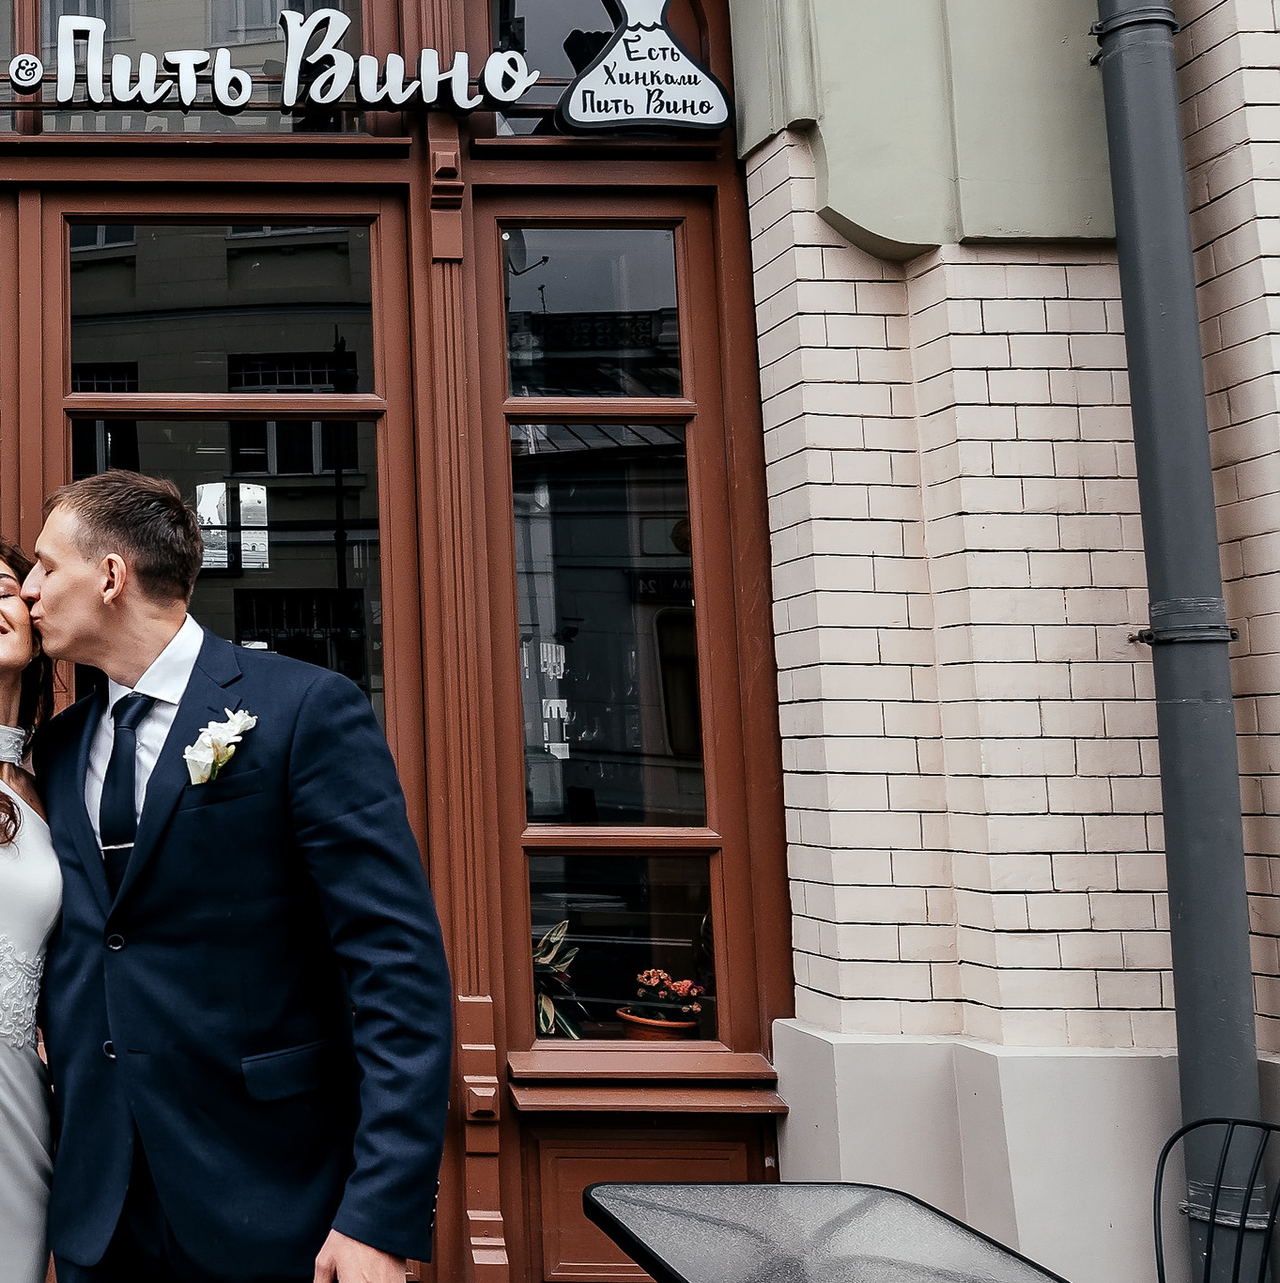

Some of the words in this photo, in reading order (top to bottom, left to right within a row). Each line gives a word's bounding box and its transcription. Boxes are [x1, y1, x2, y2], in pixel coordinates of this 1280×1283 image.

[56, 15, 253, 108] Пить
[280, 8, 540, 109] Вино
[622, 34, 681, 62] Есть
[602, 61, 702, 87] Хинкали
[581, 89, 635, 115] Пить
[645, 88, 715, 116] Вино
